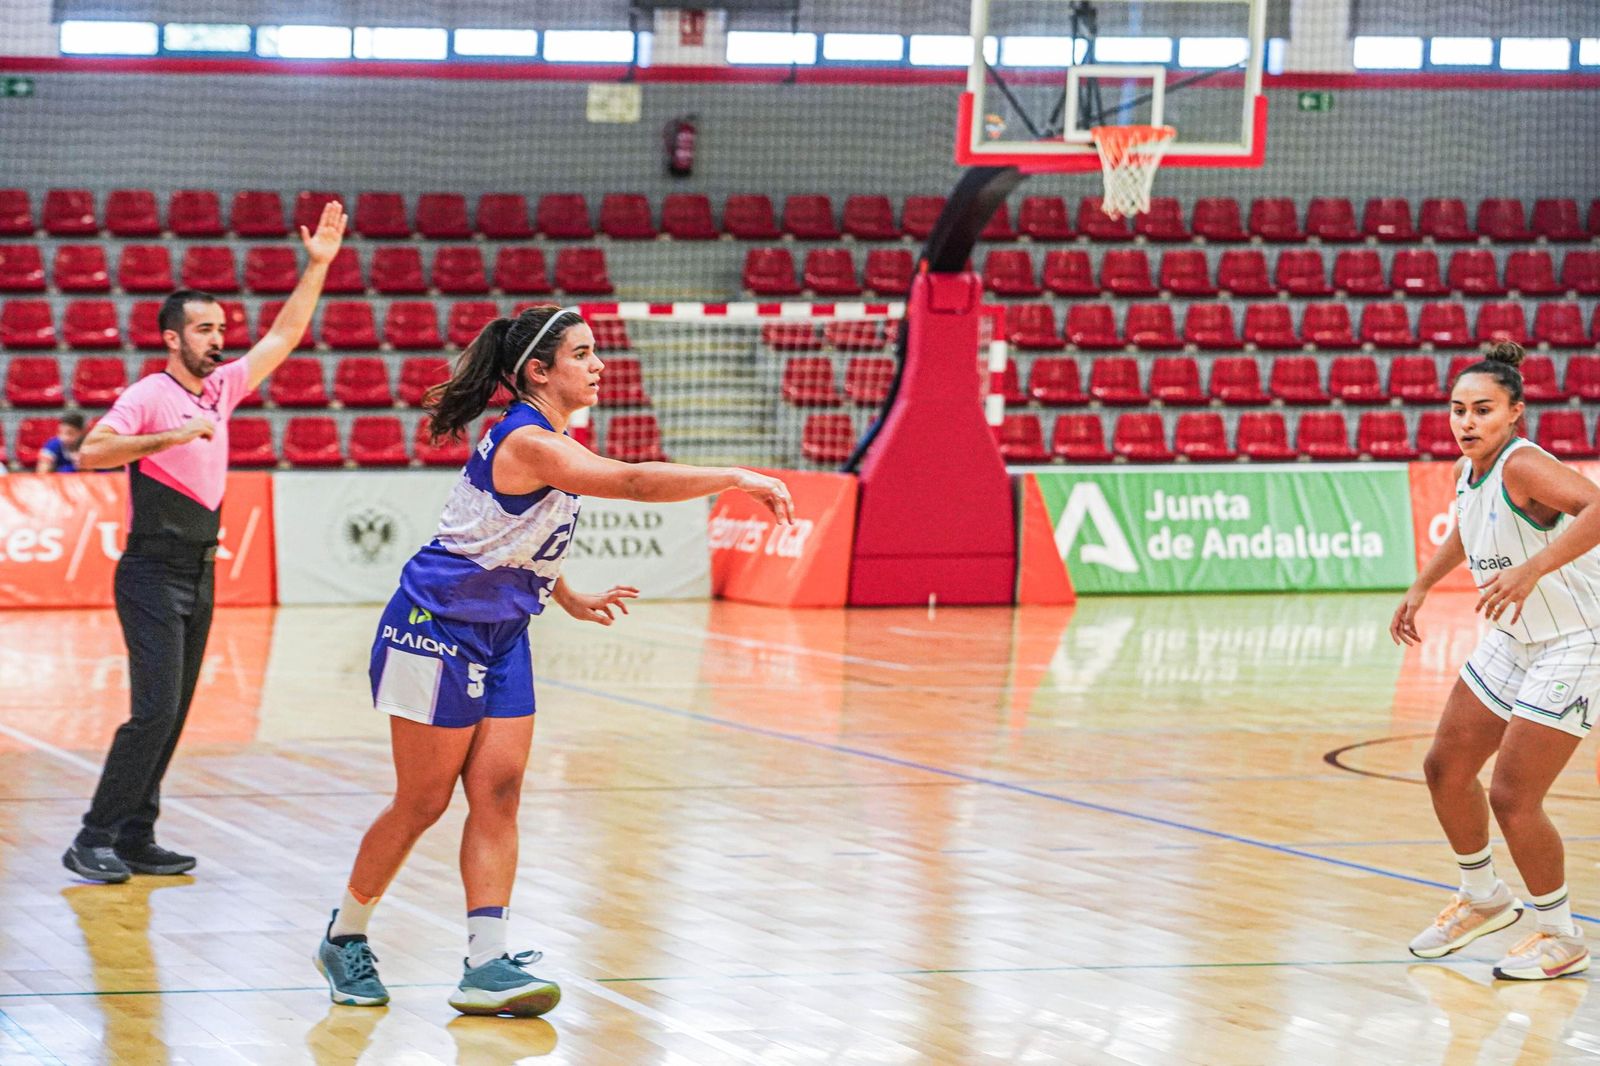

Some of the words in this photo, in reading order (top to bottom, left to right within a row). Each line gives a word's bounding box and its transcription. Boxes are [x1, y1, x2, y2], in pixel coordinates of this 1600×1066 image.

[578, 511, 664, 530] SIDAD
[1145, 490, 1250, 521] Junta
[568, 536, 664, 559] NADA
[1147, 526, 1195, 560] de
[1202, 520, 1385, 560] Andalucía
[382, 625, 458, 657] PLAION
[466, 662, 489, 699] 5
